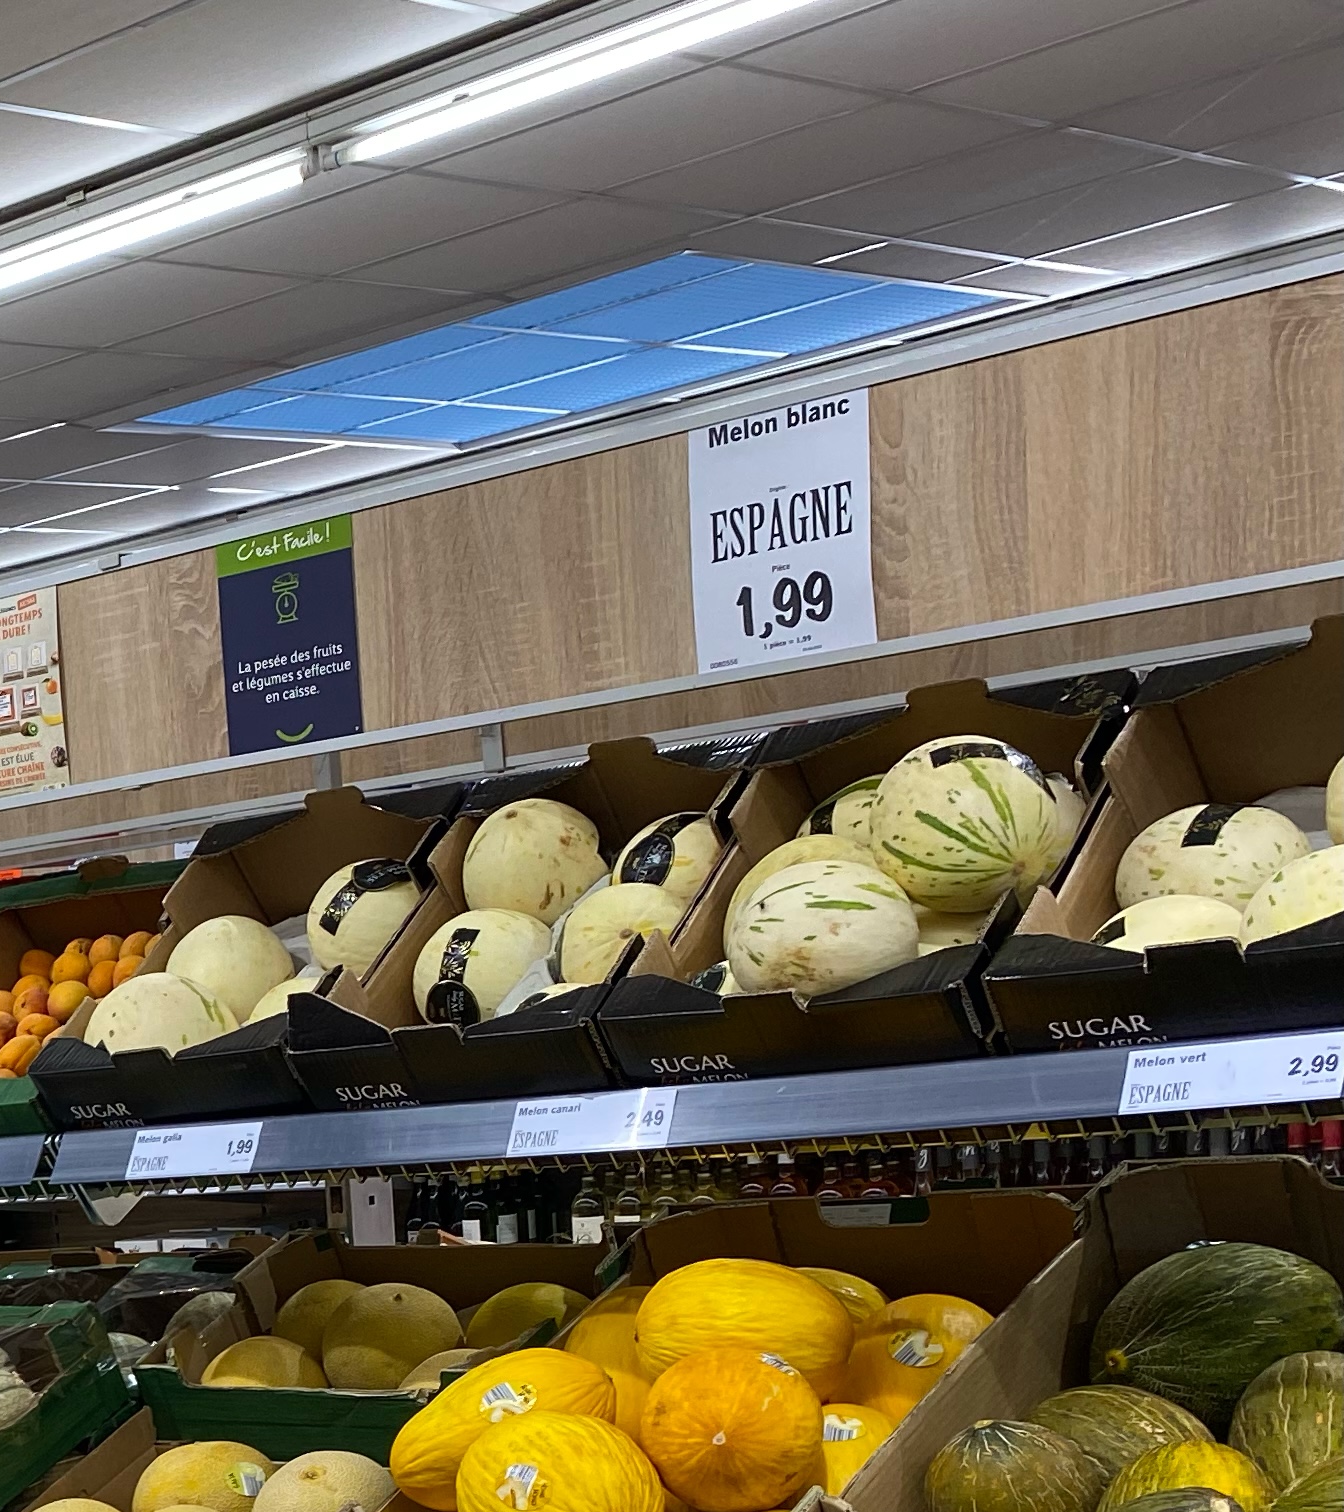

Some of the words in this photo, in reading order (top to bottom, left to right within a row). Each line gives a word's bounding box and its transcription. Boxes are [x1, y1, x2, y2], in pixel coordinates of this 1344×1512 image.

[708, 416, 778, 448] Melon
[787, 398, 850, 429] blanc
[710, 481, 852, 564] ESPAGNE
[237, 536, 279, 561] C'est
[282, 527, 324, 551] Facile
[736, 570, 833, 639] 1,99
[3, 625, 26, 639] DURE
[238, 661, 251, 674] La
[254, 654, 287, 674] pesée
[291, 649, 310, 664] des
[313, 643, 343, 659] fruits
[232, 679, 243, 693] et
[246, 672, 294, 691] légumes
[297, 659, 351, 681] s'effectue
[266, 692, 280, 703] en
[2, 756, 14, 766] EST
[16, 752, 34, 763] ÉLUE
[1049, 1015, 1152, 1039] SUGAR
[651, 1054, 735, 1074] SUGAR
[1134, 1056, 1175, 1069] Melon
[1180, 1052, 1207, 1065] vert
[1288, 1054, 1339, 1077] 2,99
[336, 1083, 408, 1101] SUGAR
[1128, 1081, 1192, 1105] ESPAGNE
[70, 1102, 132, 1120] SUGAR
[518, 1106, 548, 1116] Melon
[551, 1103, 581, 1114] canari
[137, 1136, 161, 1144] Melon
[227, 1139, 253, 1157] 1,99
[512, 1130, 559, 1149] ESPAGNE
[131, 1156, 169, 1172] ESPAGNE
